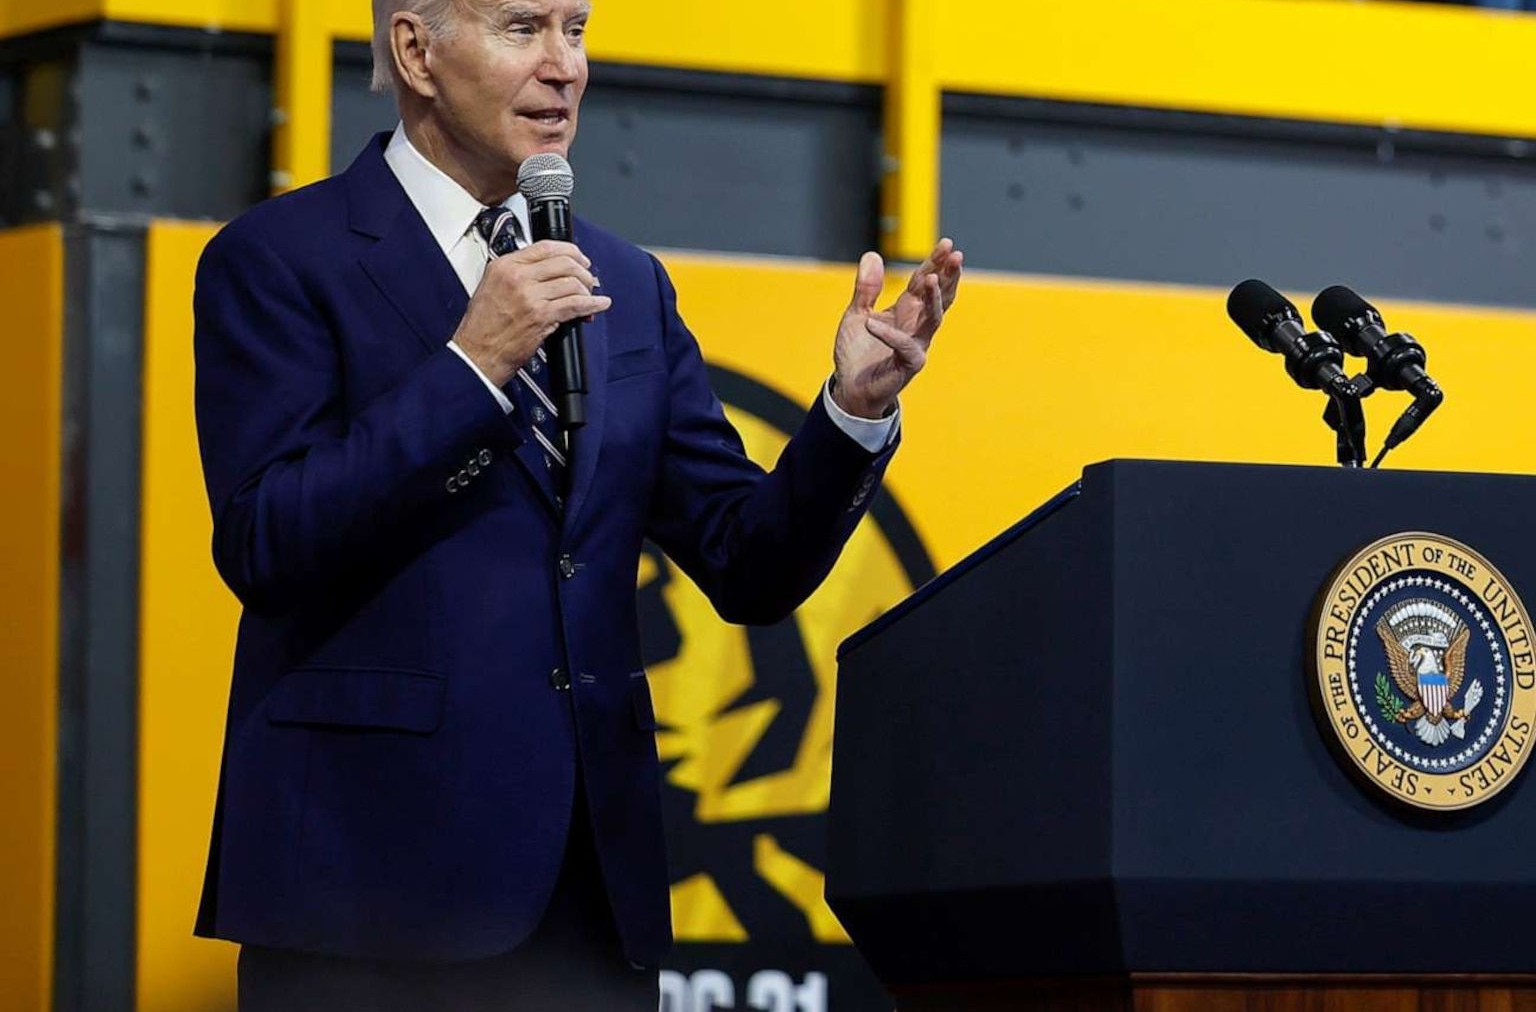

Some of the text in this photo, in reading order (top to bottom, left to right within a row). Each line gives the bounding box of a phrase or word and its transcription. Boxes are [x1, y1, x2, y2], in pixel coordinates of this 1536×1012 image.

[1324, 543, 1535, 797] SEAL OF THE PRESIDENT OF THE UNITED STATES
